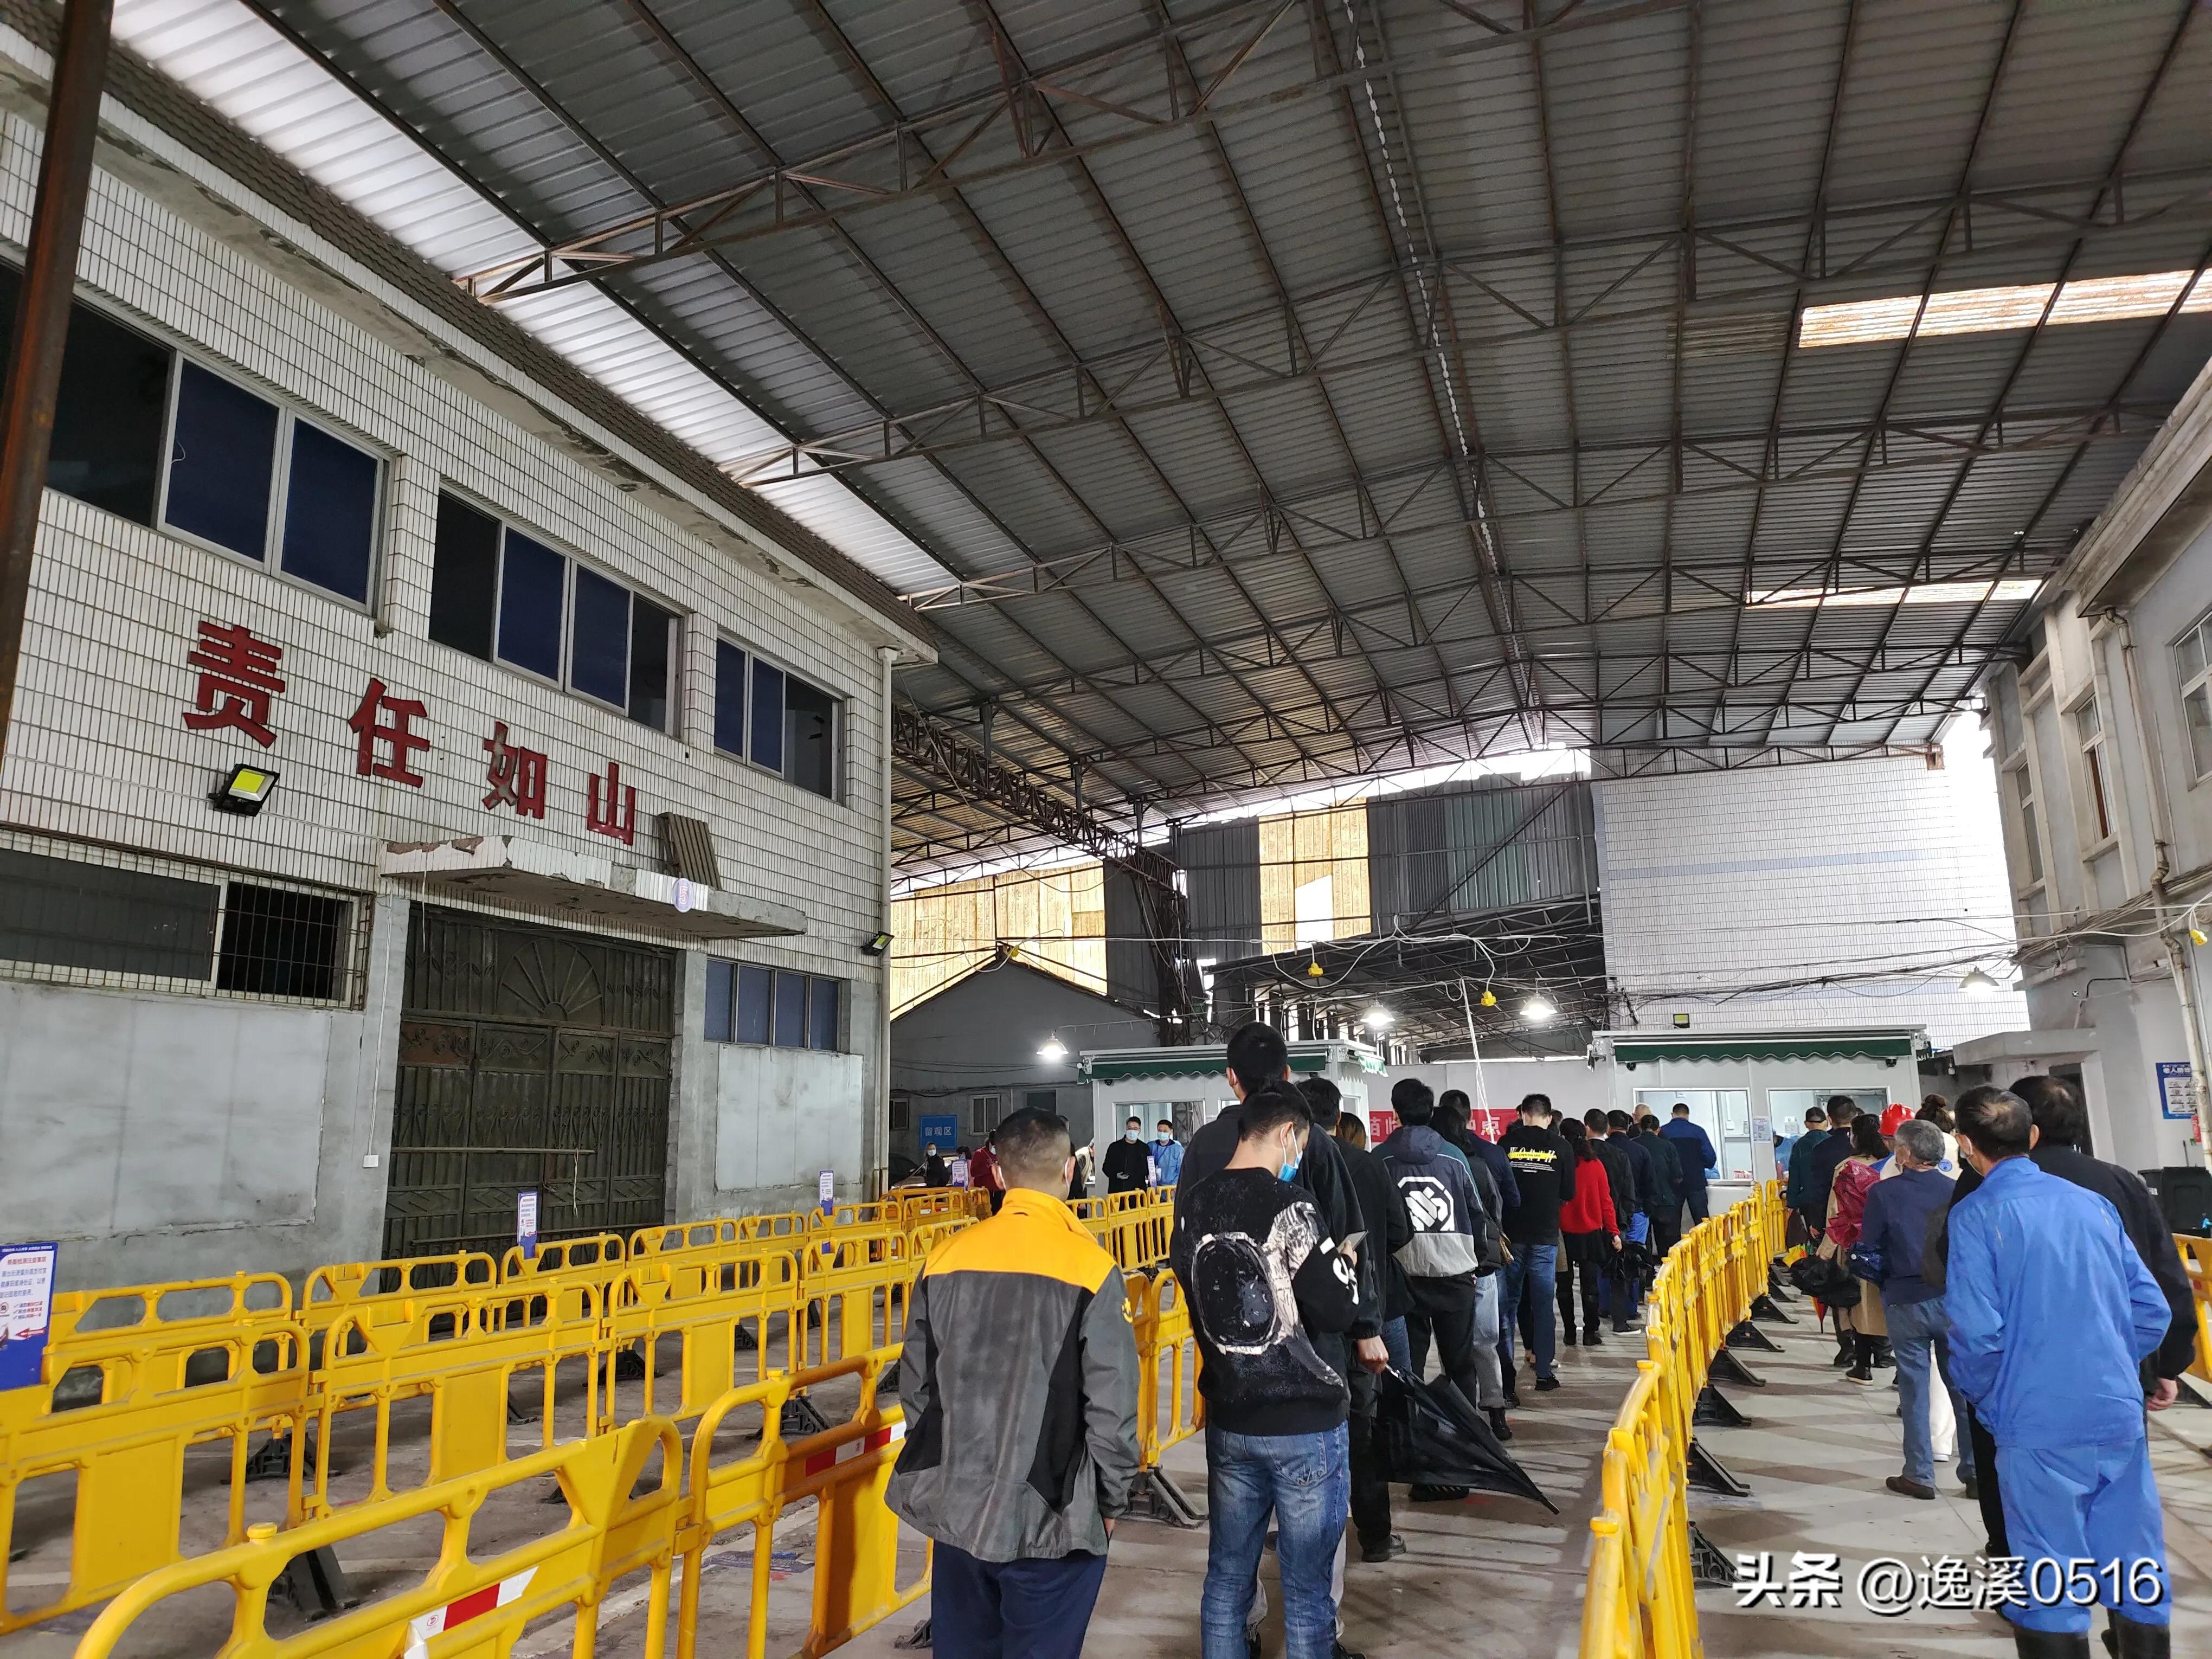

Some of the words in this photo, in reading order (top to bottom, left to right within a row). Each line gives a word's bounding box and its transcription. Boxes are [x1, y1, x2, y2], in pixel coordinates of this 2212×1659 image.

[183, 620, 636, 845] 责任如山
[679, 885, 689, 905] 5
